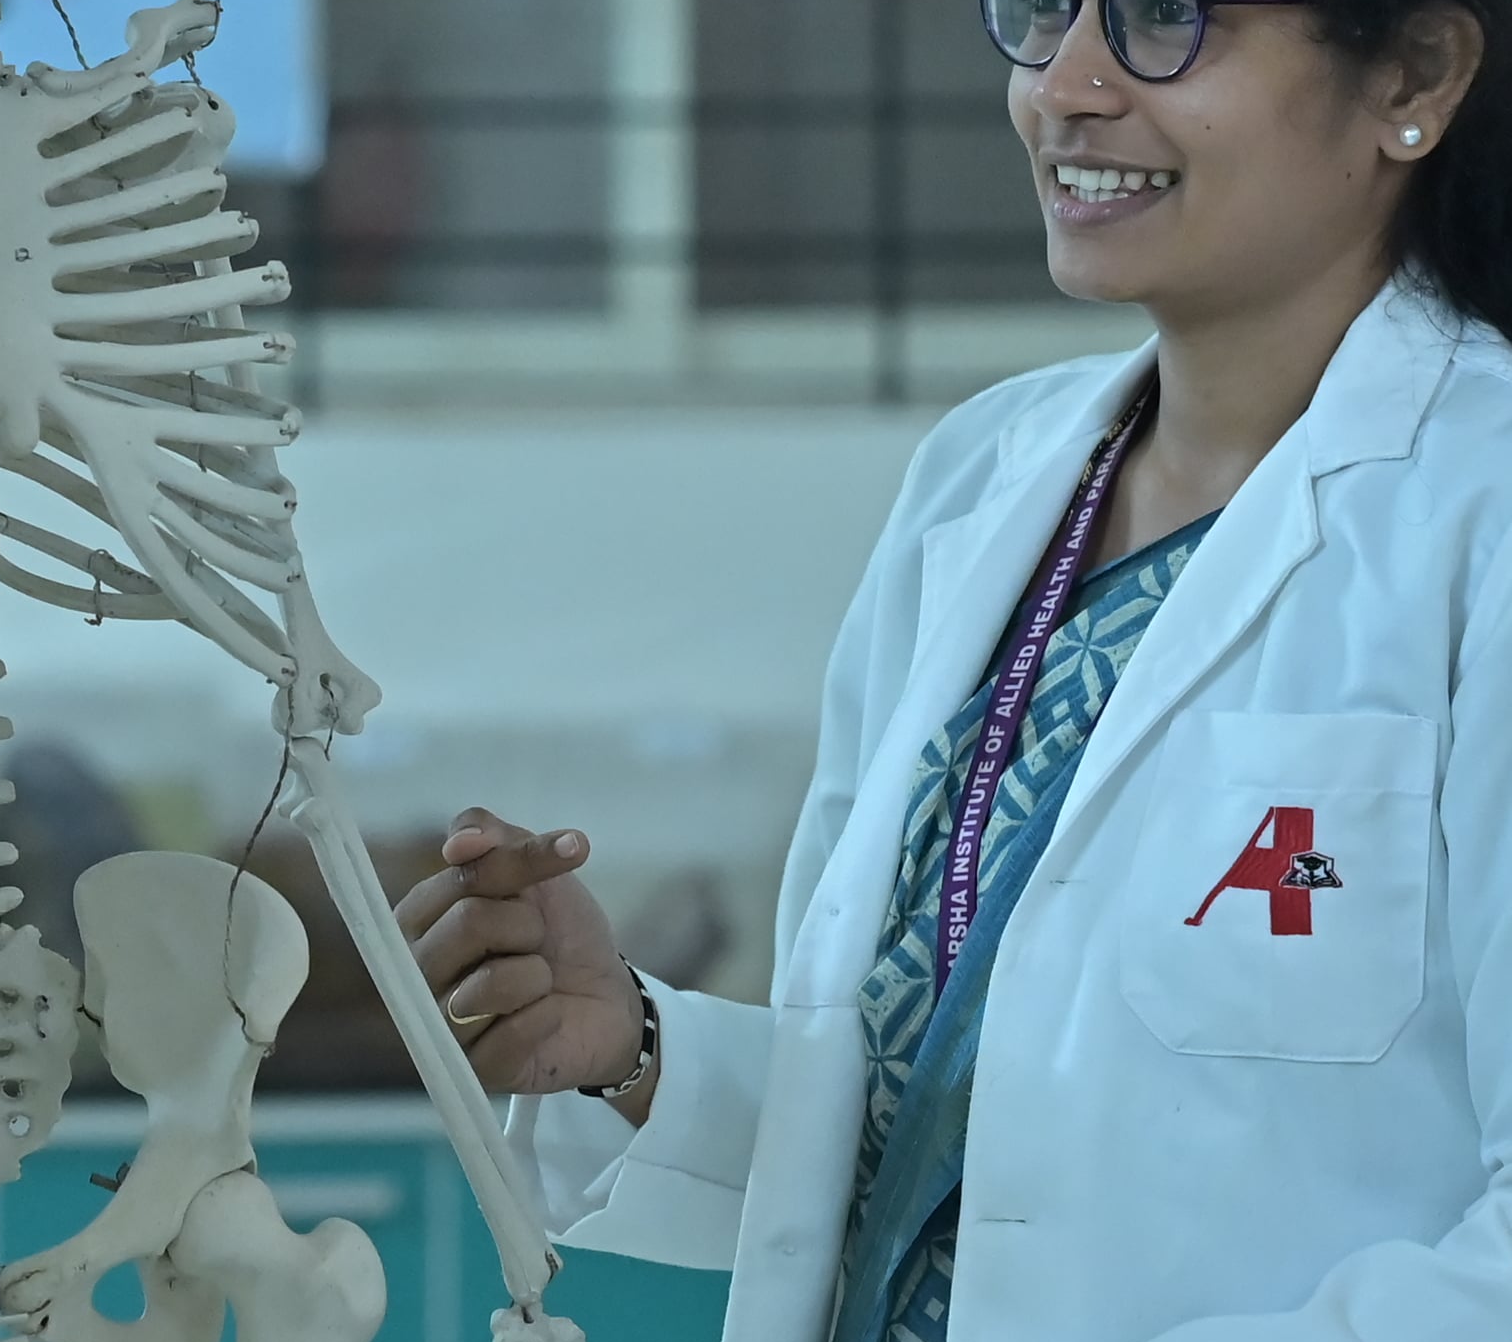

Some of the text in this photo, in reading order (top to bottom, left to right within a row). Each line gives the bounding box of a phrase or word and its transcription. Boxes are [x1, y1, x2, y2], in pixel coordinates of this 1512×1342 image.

[952, 759, 995, 882] INSTITUTE
[984, 724, 1005, 753] OF
[996, 644, 1037, 718] ALLIED
[1028, 557, 1075, 639] HEALTH
[1067, 507, 1093, 549] AND
